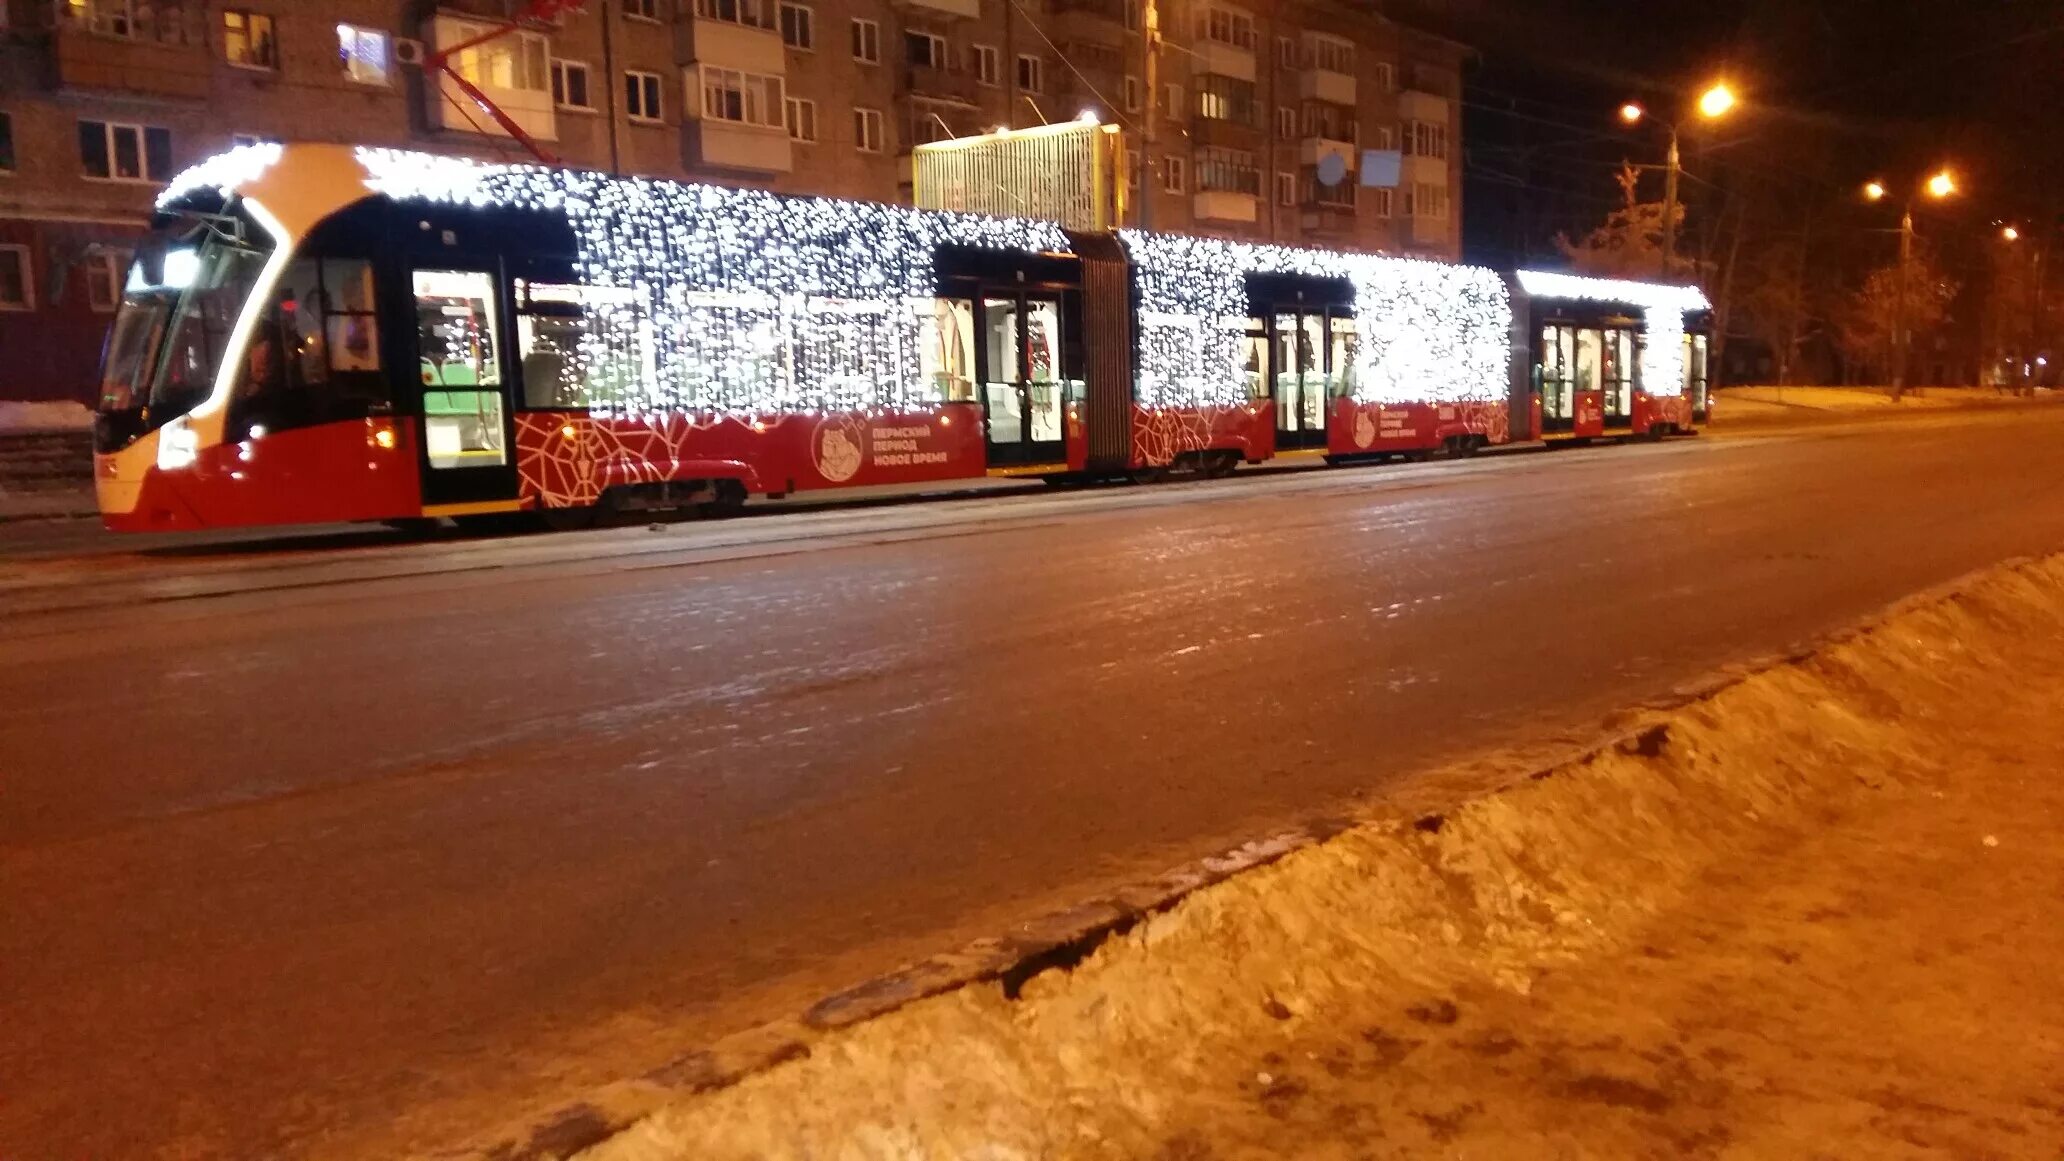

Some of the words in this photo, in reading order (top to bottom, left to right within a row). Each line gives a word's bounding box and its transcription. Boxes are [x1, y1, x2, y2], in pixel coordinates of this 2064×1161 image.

[872, 425, 931, 439] ПЕРМСКИЙ
[872, 440, 917, 451] ПЕРИОД
[873, 454, 911, 466] НОВОЕ
[912, 452, 948, 464] ВРЕМЯ
